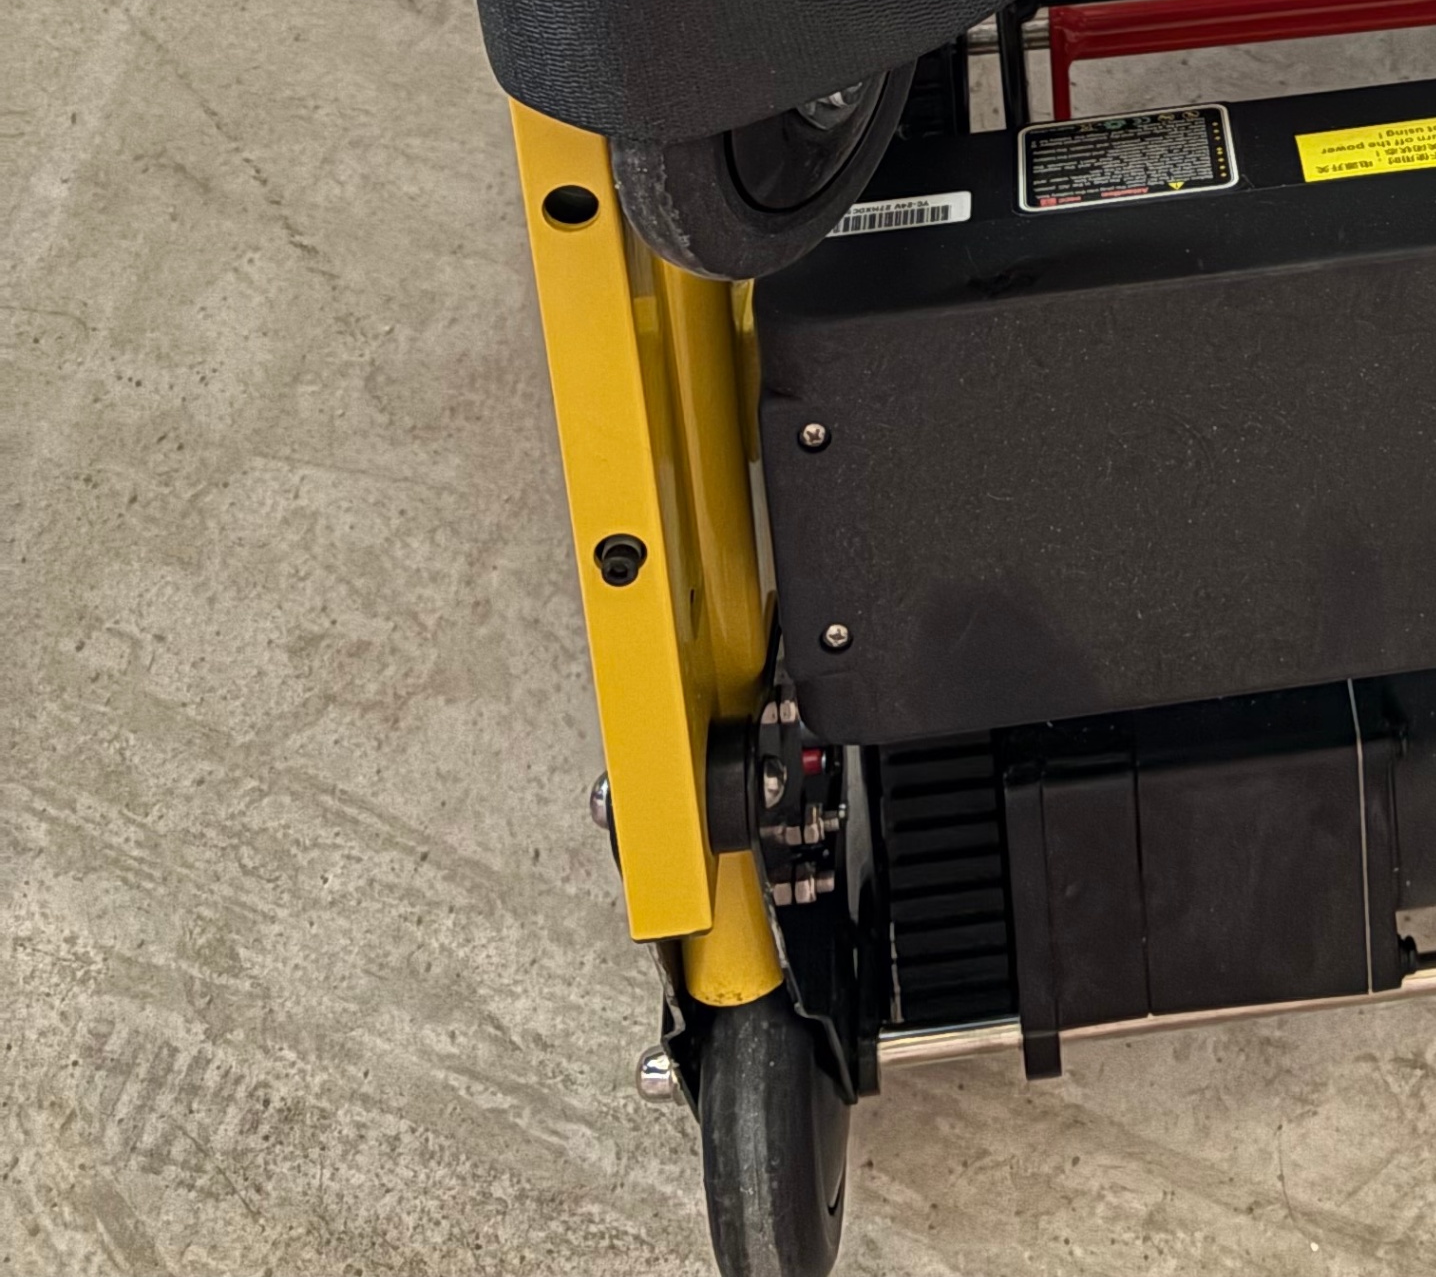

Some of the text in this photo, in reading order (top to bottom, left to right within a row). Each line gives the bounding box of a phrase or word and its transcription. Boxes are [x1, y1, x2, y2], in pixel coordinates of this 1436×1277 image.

[1386, 126, 1424, 137] using
[1368, 140, 1391, 148] the
[1393, 137, 1413, 145] off
[1321, 142, 1364, 153] power
